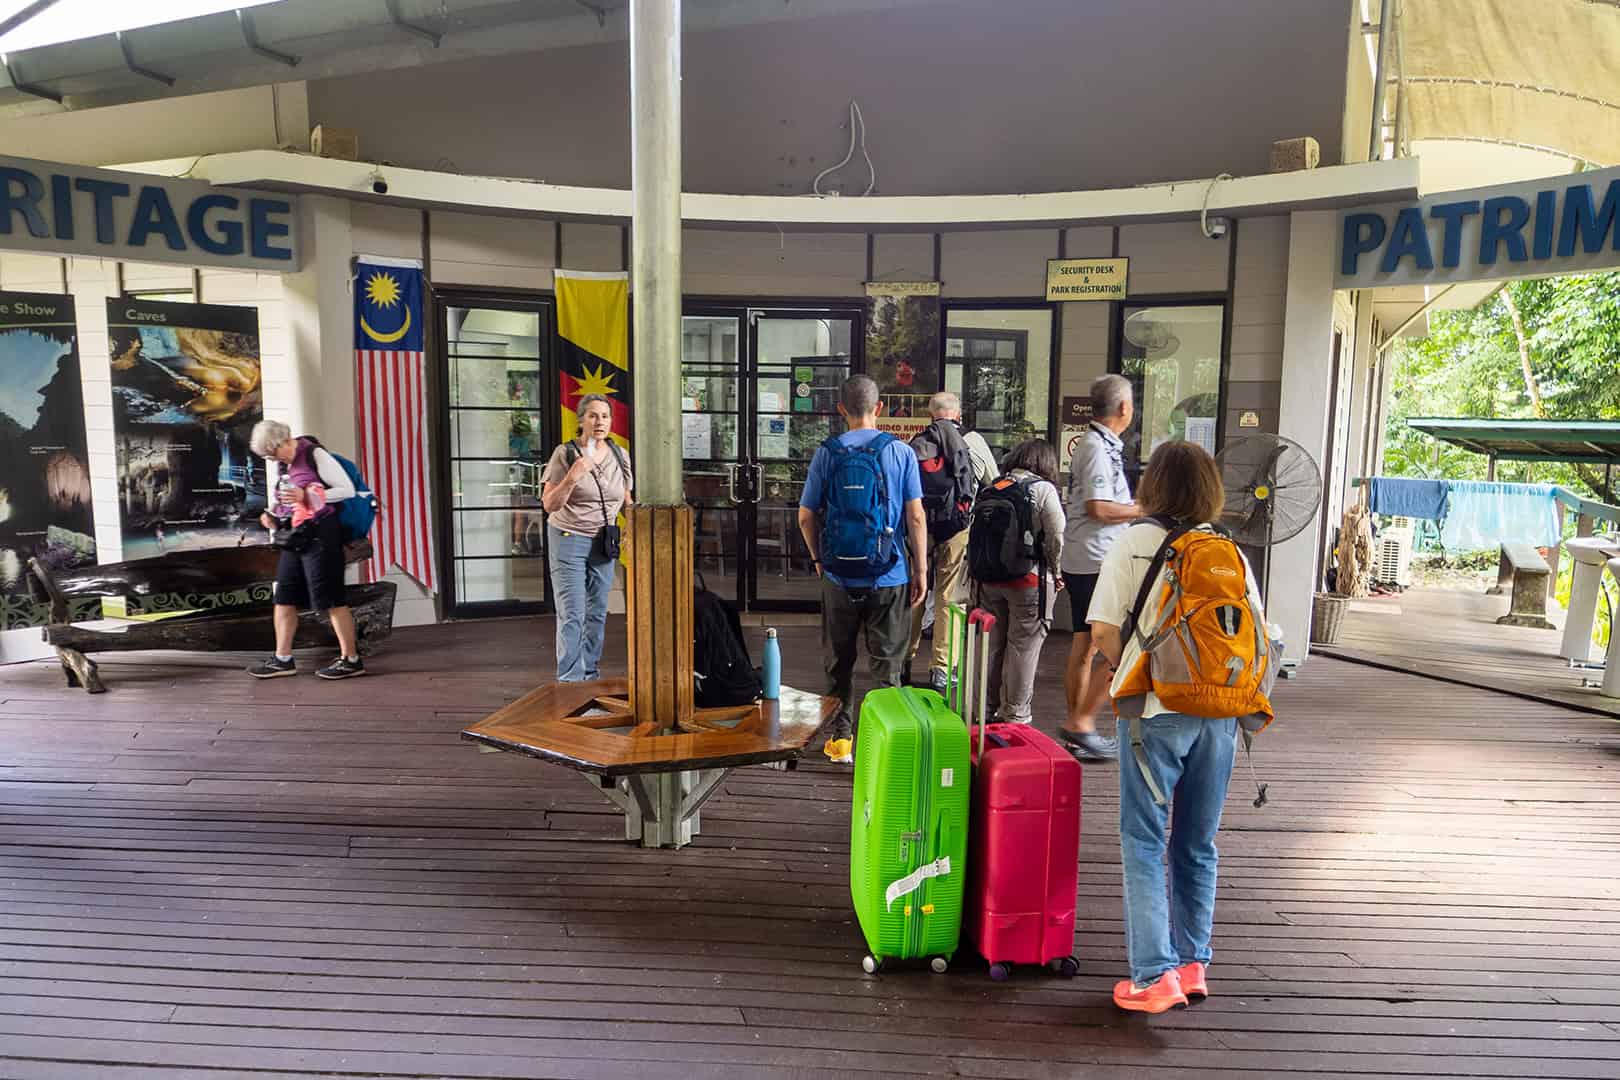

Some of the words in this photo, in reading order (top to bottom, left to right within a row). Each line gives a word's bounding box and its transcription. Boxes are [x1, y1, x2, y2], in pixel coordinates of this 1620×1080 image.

[0, 167, 292, 261] RITAGE
[1342, 179, 1620, 276] PATRIM
[1060, 265, 1094, 275] SECURITY
[1095, 264, 1114, 274] DESK
[1083, 276, 1090, 284] &
[1051, 286, 1070, 295] PARK
[1071, 284, 1122, 294] REGISTRATION
[15, 302, 57, 316] Show
[126, 308, 168, 322] Caves
[1073, 403, 1093, 413] Open
